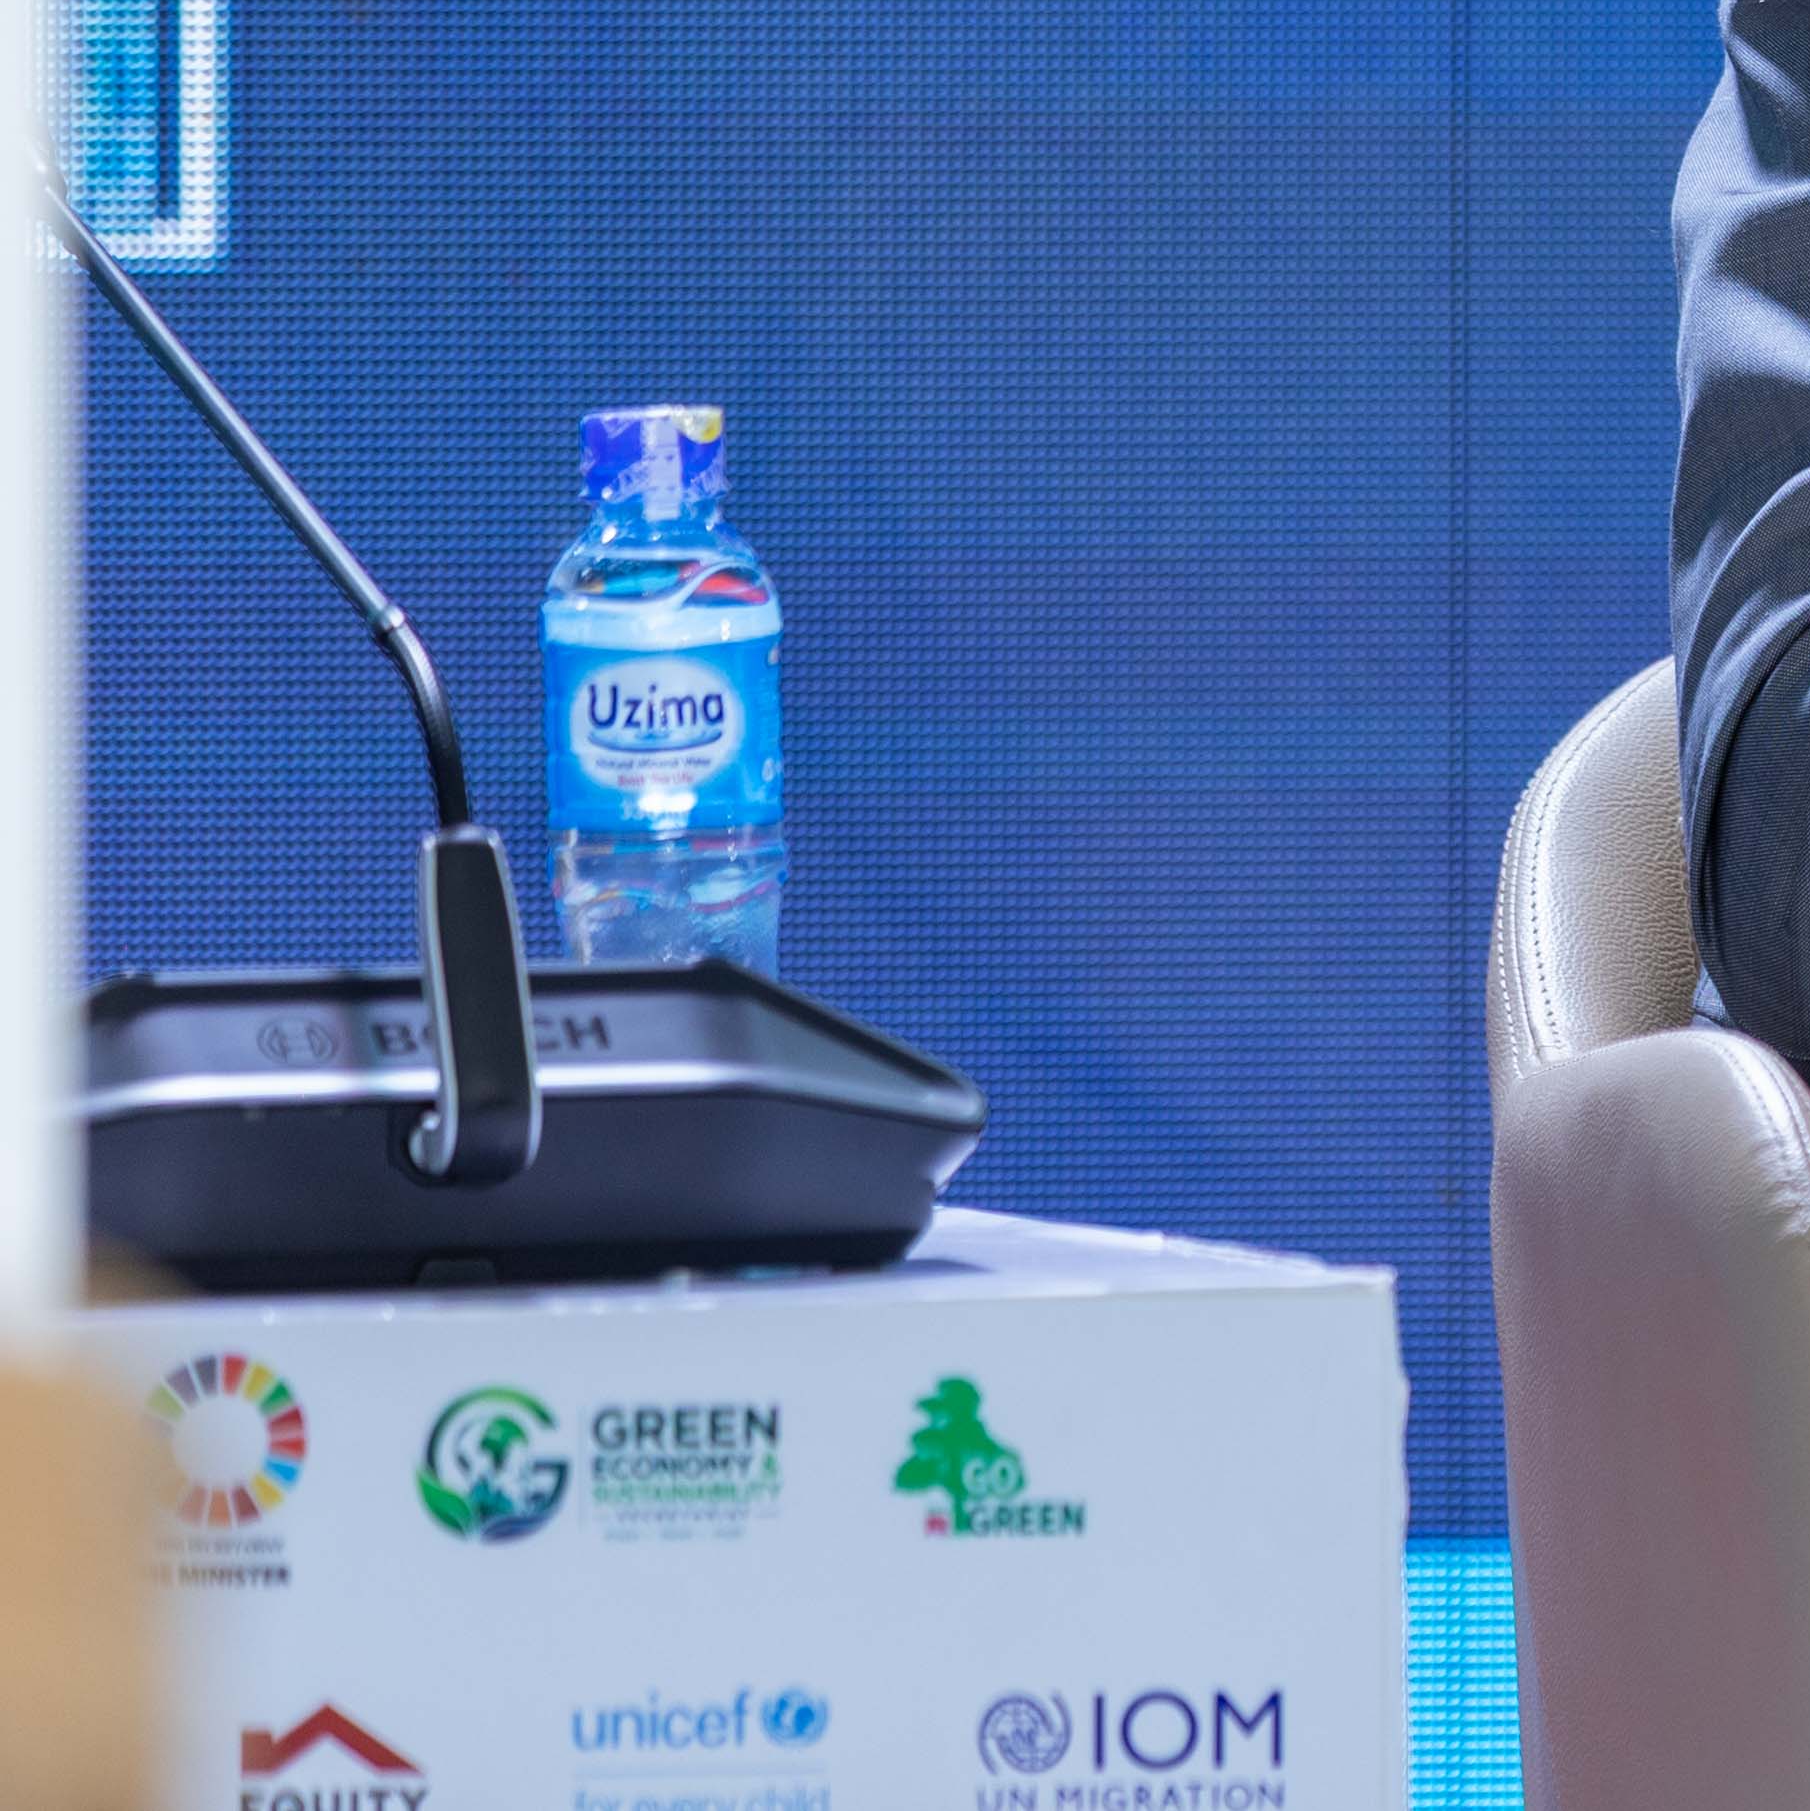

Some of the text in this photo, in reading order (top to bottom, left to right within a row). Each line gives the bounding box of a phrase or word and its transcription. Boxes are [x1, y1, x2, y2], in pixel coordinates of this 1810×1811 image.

[587, 682, 726, 729] Uzima
[371, 1014, 611, 1053] BCH
[592, 1405, 779, 1449] GREEN
[592, 1456, 751, 1480] ECONOMY
[964, 1457, 1020, 1496] GO
[970, 1501, 1085, 1535] GREEN
[573, 1687, 752, 1750] unicef
[1093, 1690, 1285, 1772] IOM
[976, 1784, 1285, 1811] UN MIGRATION
